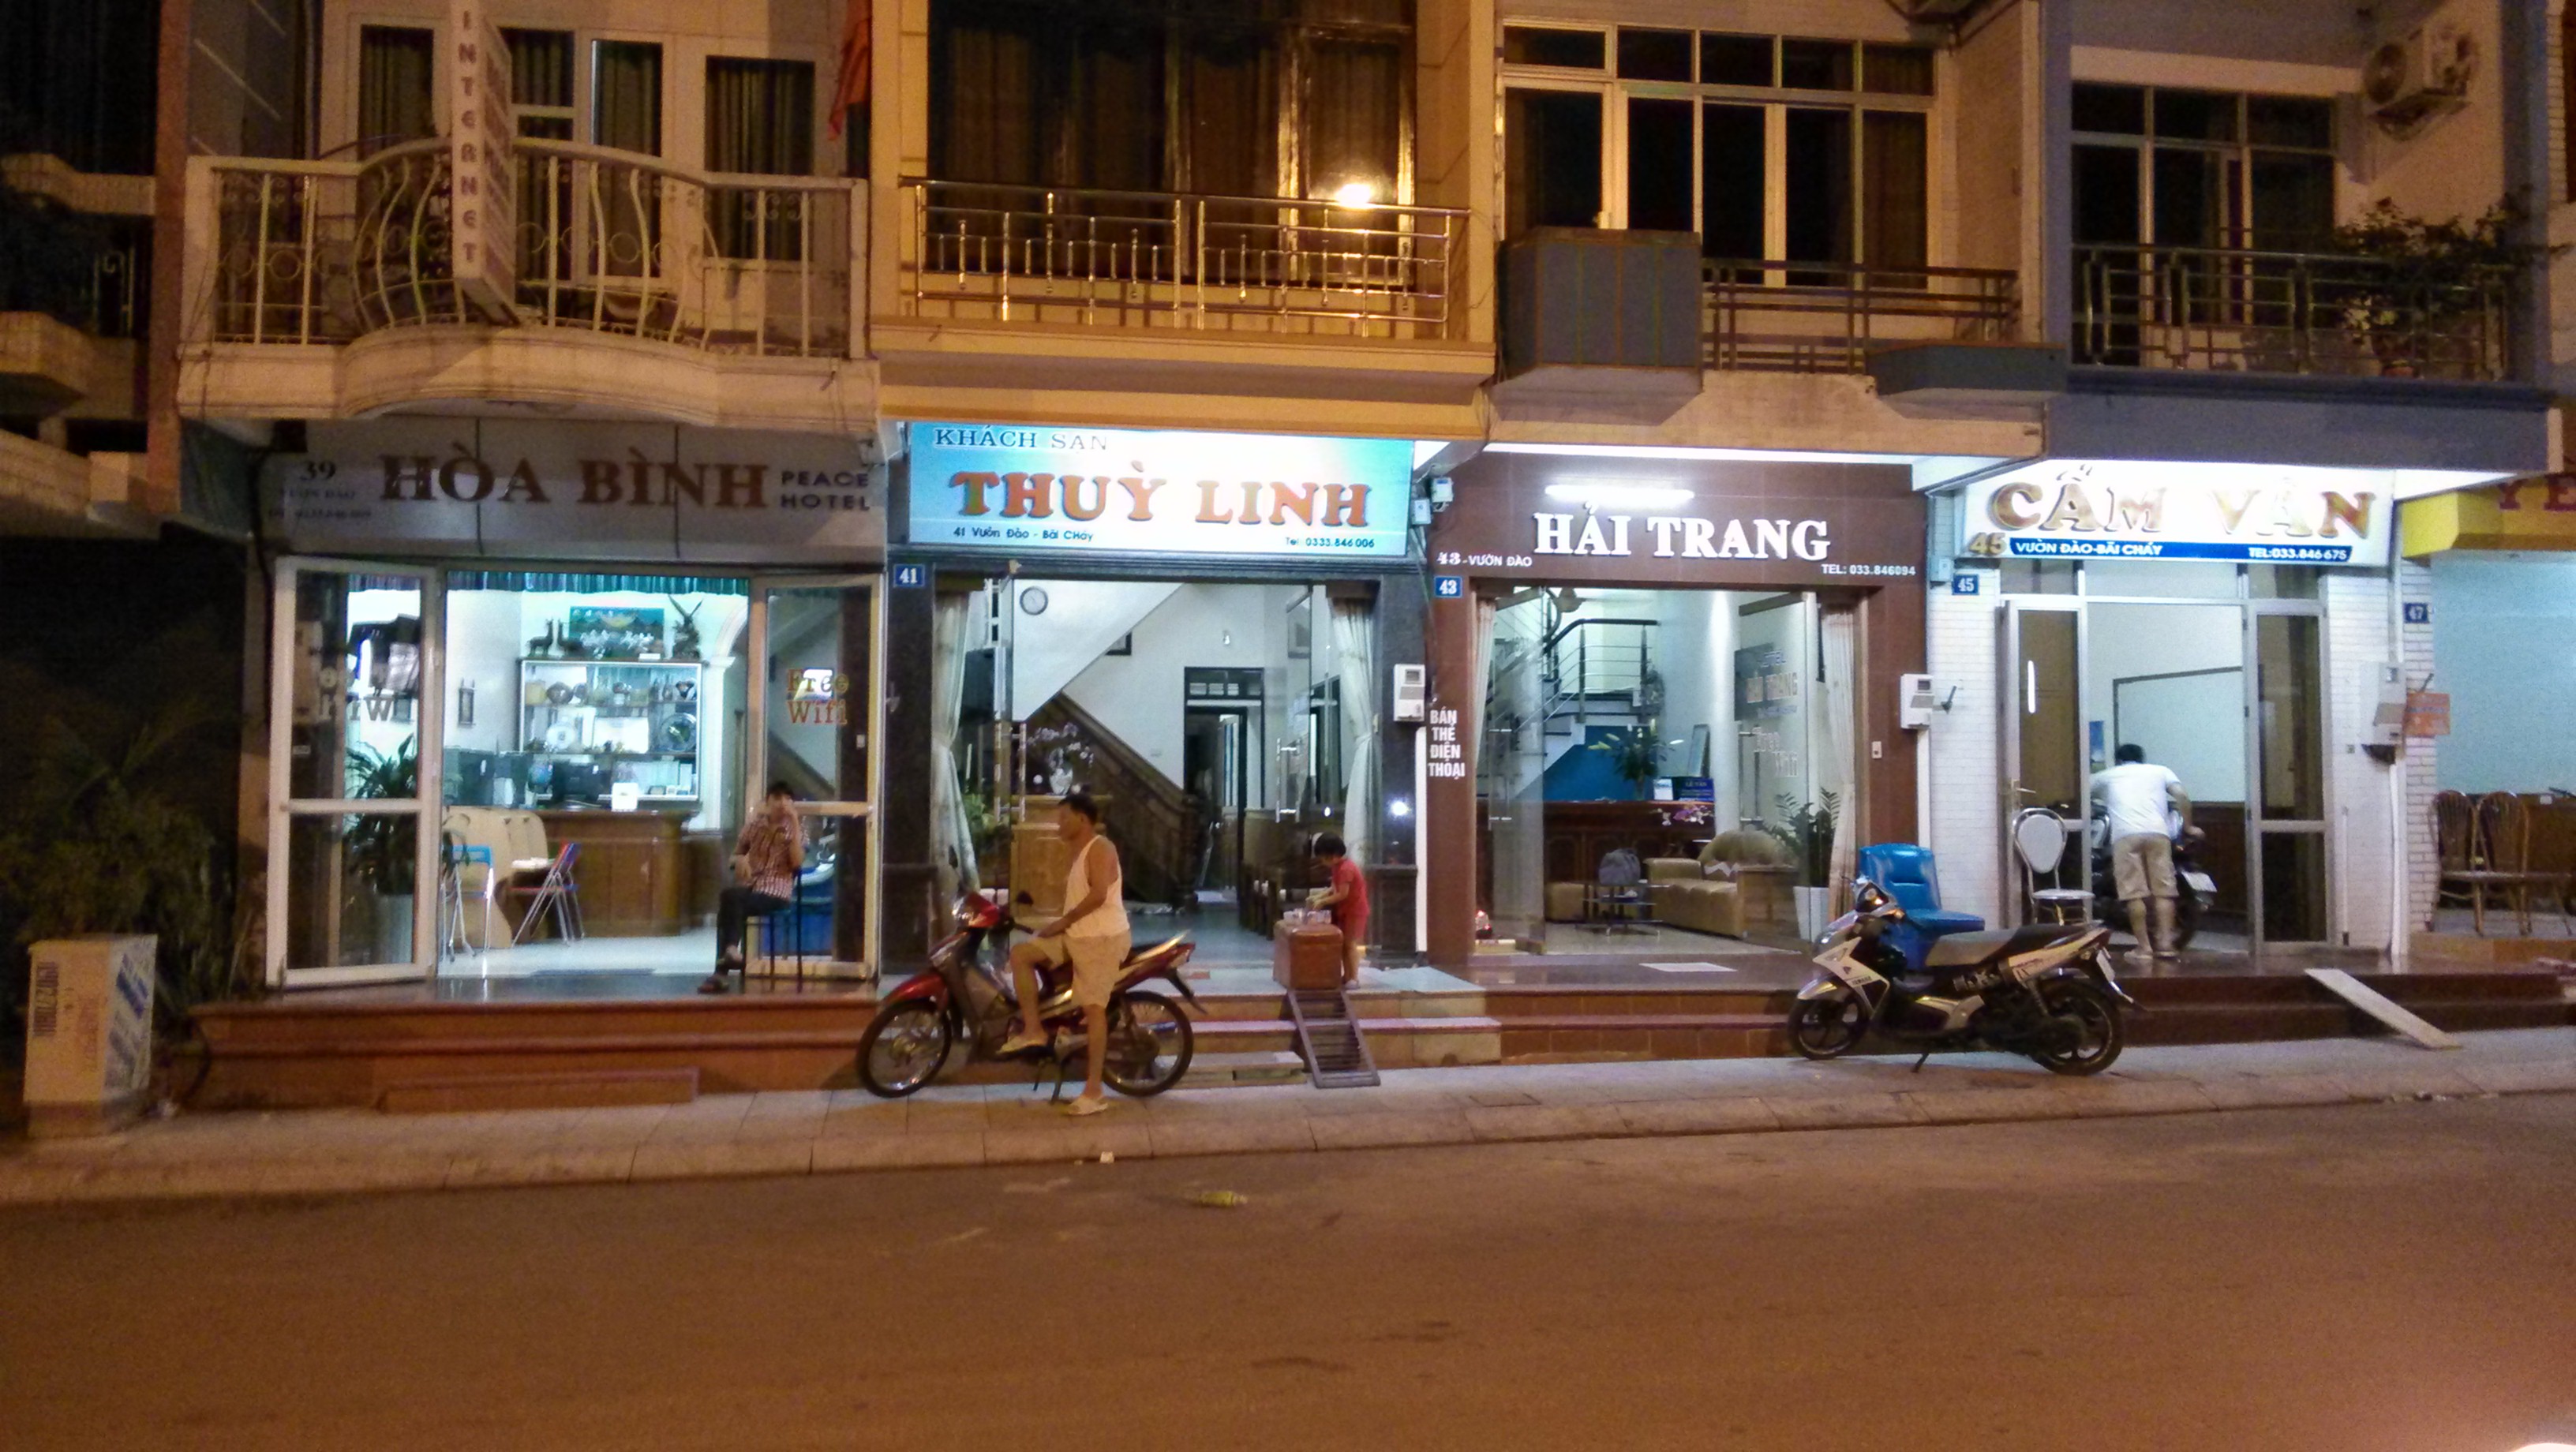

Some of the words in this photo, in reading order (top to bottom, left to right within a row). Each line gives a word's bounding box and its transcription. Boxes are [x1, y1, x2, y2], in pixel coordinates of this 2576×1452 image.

[459, 9, 477, 263] INTERNET
[934, 425, 1037, 447] KHÁCH
[300, 461, 337, 481] 39
[379, 442, 550, 503] HÒA
[578, 447, 769, 507] BÌNH
[781, 471, 870, 487] PEACE
[781, 494, 871, 511] HOTEL
[1195, 479, 1372, 527] LINH
[953, 526, 965, 537] 41
[1533, 500, 1631, 556] HẢI
[1646, 517, 1831, 561] TRANG
[1968, 532, 2007, 556] 45
[2122, 541, 2163, 556] CHÁY
[1506, 554, 1533, 567] ĐÀO
[1821, 563, 1847, 574] TEL:
[1849, 564, 1916, 576] 033.846094
[900, 567, 918, 584] 41
[1957, 578, 1975, 592] 45
[1440, 579, 1458, 595] 43
[2409, 605, 2424, 620] 47
[786, 668, 850, 694] Free
[787, 698, 848, 724] Wifi
[1430, 705, 1458, 724] BÁN
[1431, 722, 1456, 742] THẺ
[1430, 741, 1461, 762] ĐIỆN
[1428, 762, 1466, 780] THOẠI
